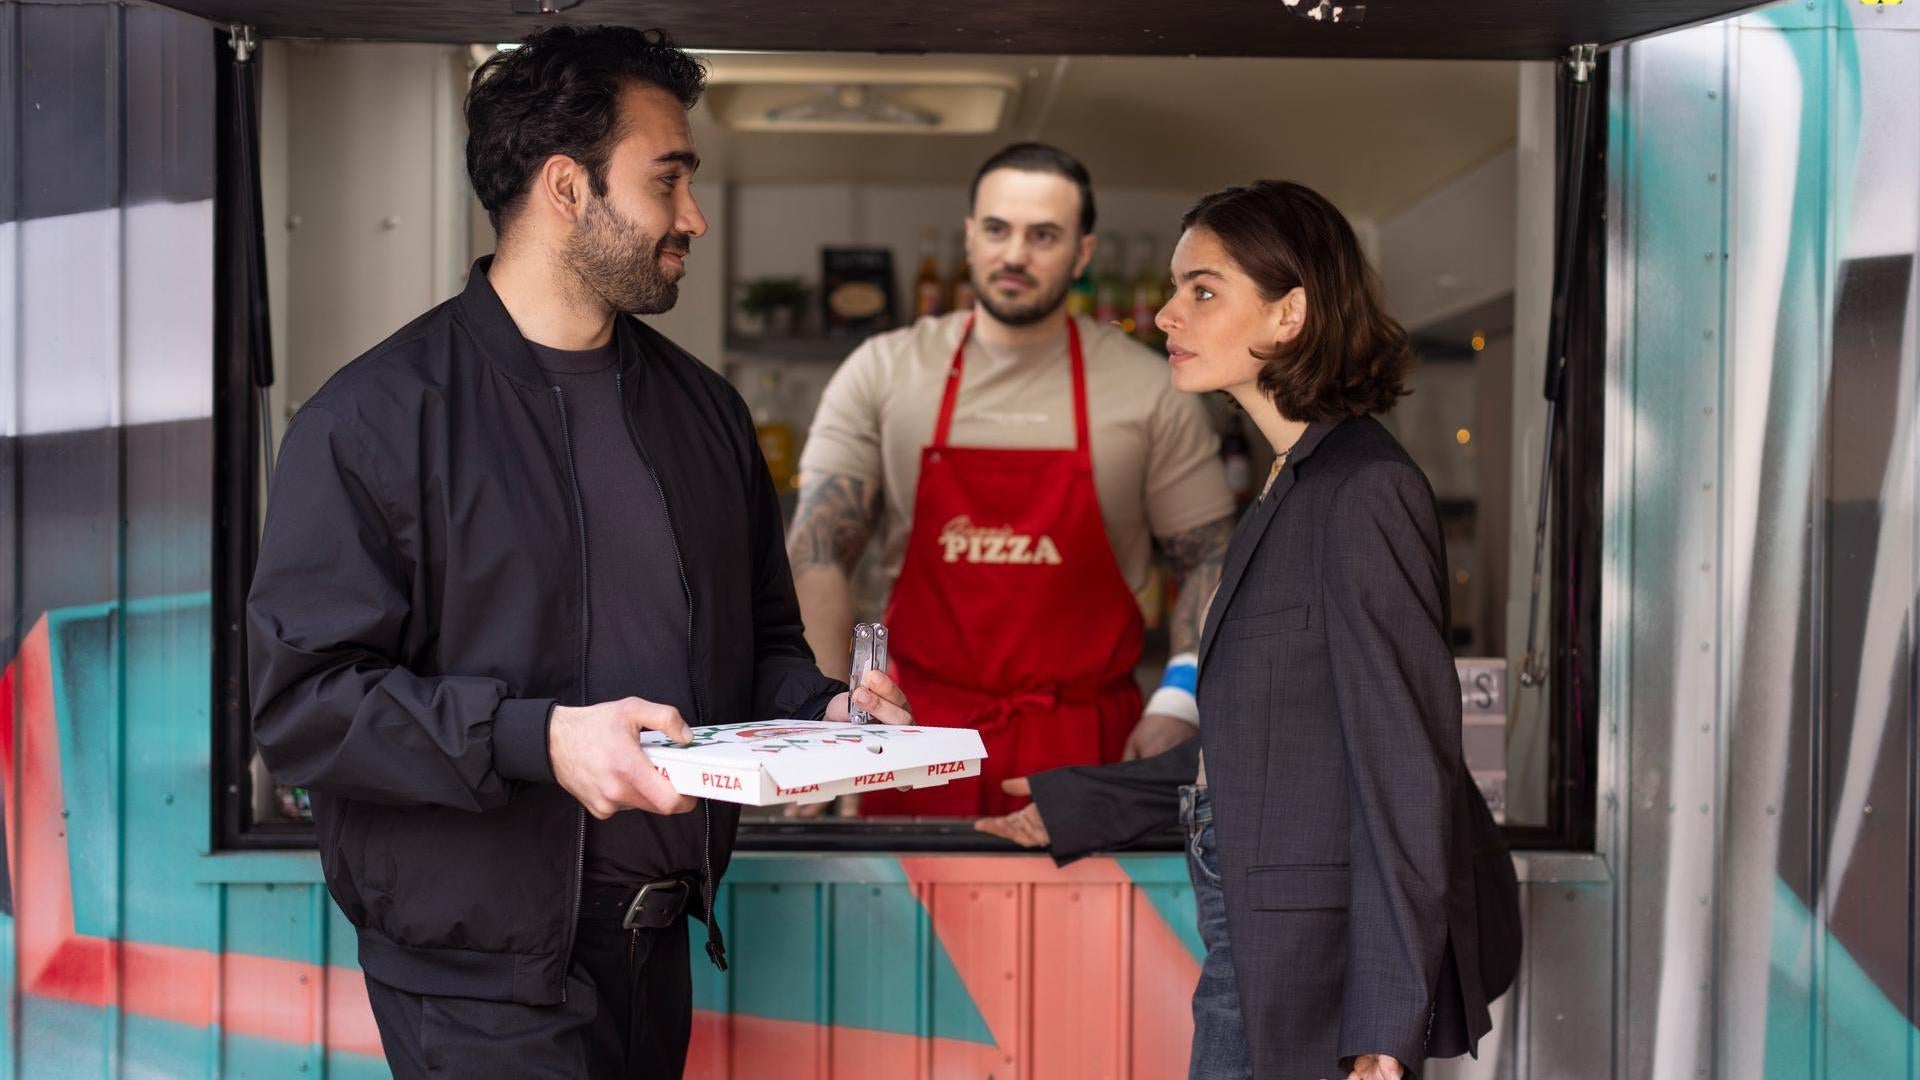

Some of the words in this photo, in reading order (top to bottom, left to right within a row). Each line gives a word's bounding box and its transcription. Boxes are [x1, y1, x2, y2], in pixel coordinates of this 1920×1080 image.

[938, 534, 1063, 564] PIZZA
[702, 772, 743, 791] PIZZA
[854, 771, 895, 786] PIZZA
[927, 760, 966, 776] PIZZA
